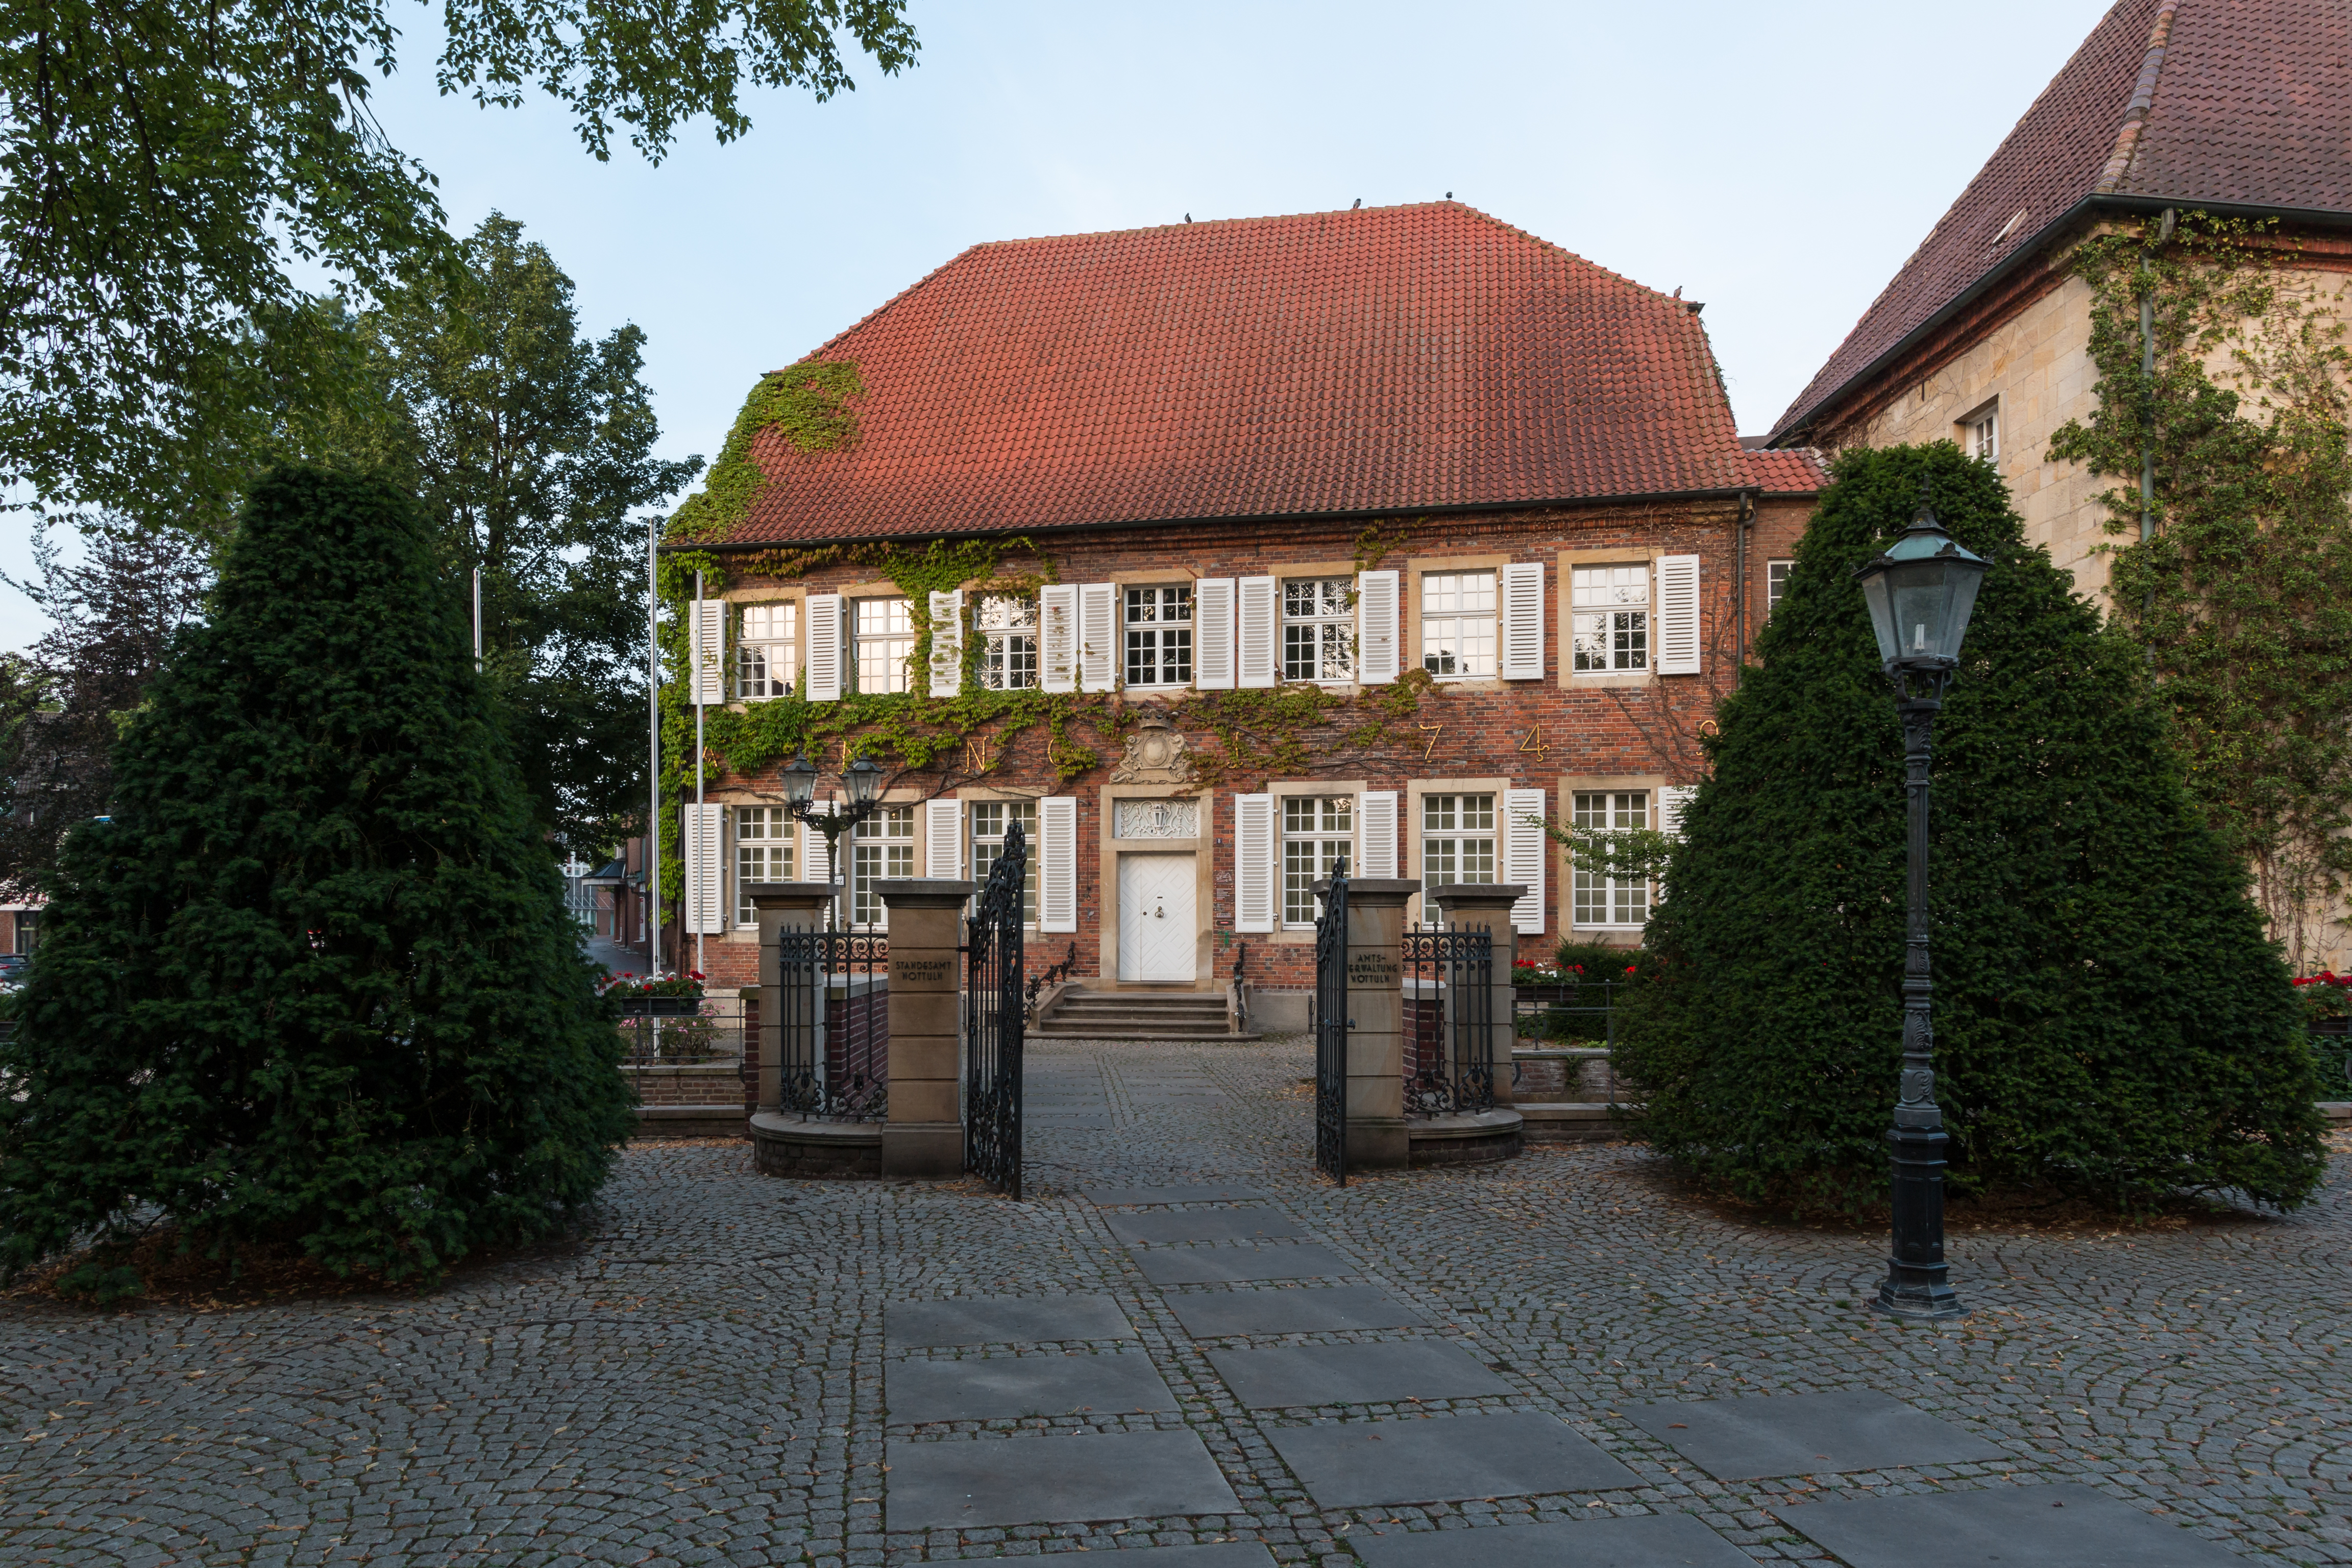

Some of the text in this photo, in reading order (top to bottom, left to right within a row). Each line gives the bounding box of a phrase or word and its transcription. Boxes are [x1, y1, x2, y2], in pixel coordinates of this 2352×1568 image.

[1358, 954, 1386, 962] AMTS-
[896, 961, 951, 970] STANDESAMT
[1348, 964, 1398, 972] ERWALTUNG
[902, 972, 943, 981] NOTTULN
[1351, 974, 1389, 983] NOTTULN
